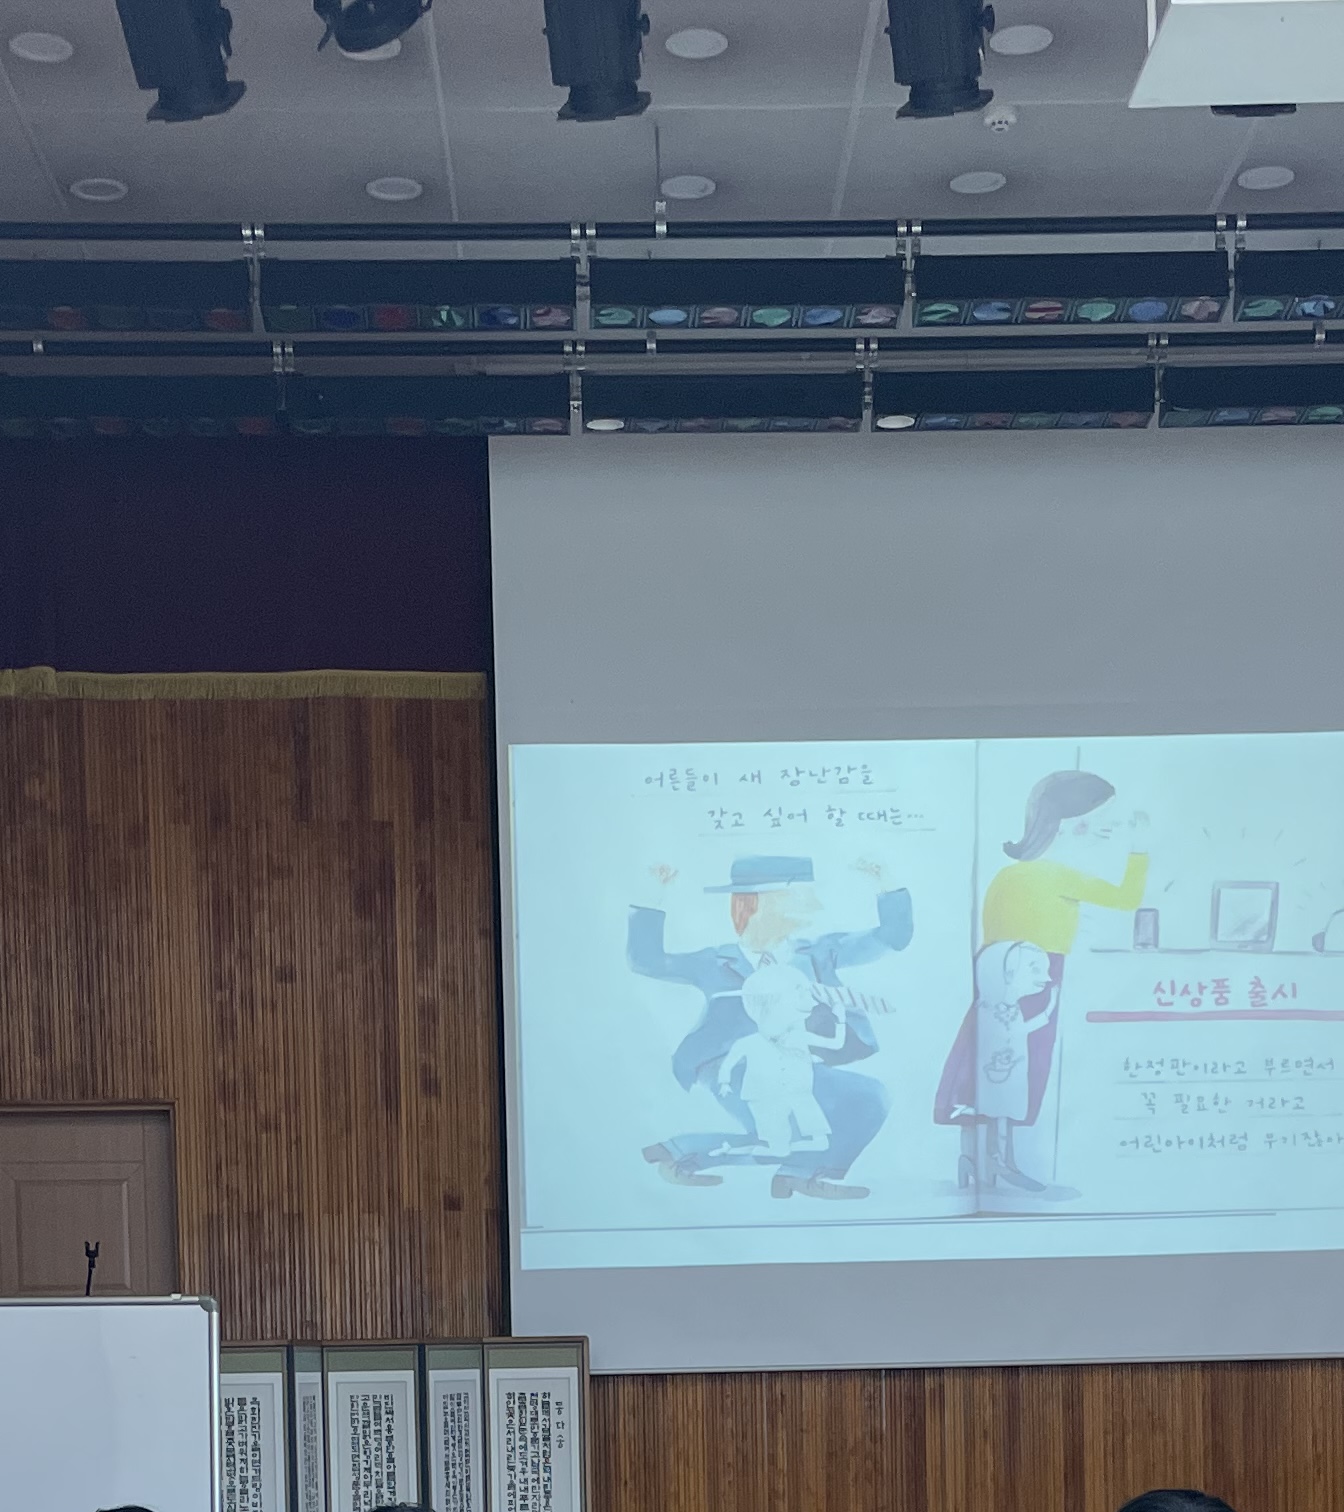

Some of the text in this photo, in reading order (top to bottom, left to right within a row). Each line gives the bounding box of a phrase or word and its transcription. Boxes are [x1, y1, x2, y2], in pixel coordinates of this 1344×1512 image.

[644, 764, 874, 792] 어른들이 새 장난감을
[707, 806, 745, 830] 갖고
[762, 806, 808, 828] 싶어
[825, 804, 847, 827] 할
[1152, 975, 1298, 1008] 신상품 출시
[1123, 1056, 1335, 1078] 한정판이라고 부르면서
[1140, 1091, 1306, 1115] 꼭 필요한 거라고
[1119, 1131, 1249, 1154] 어린아이처럼
